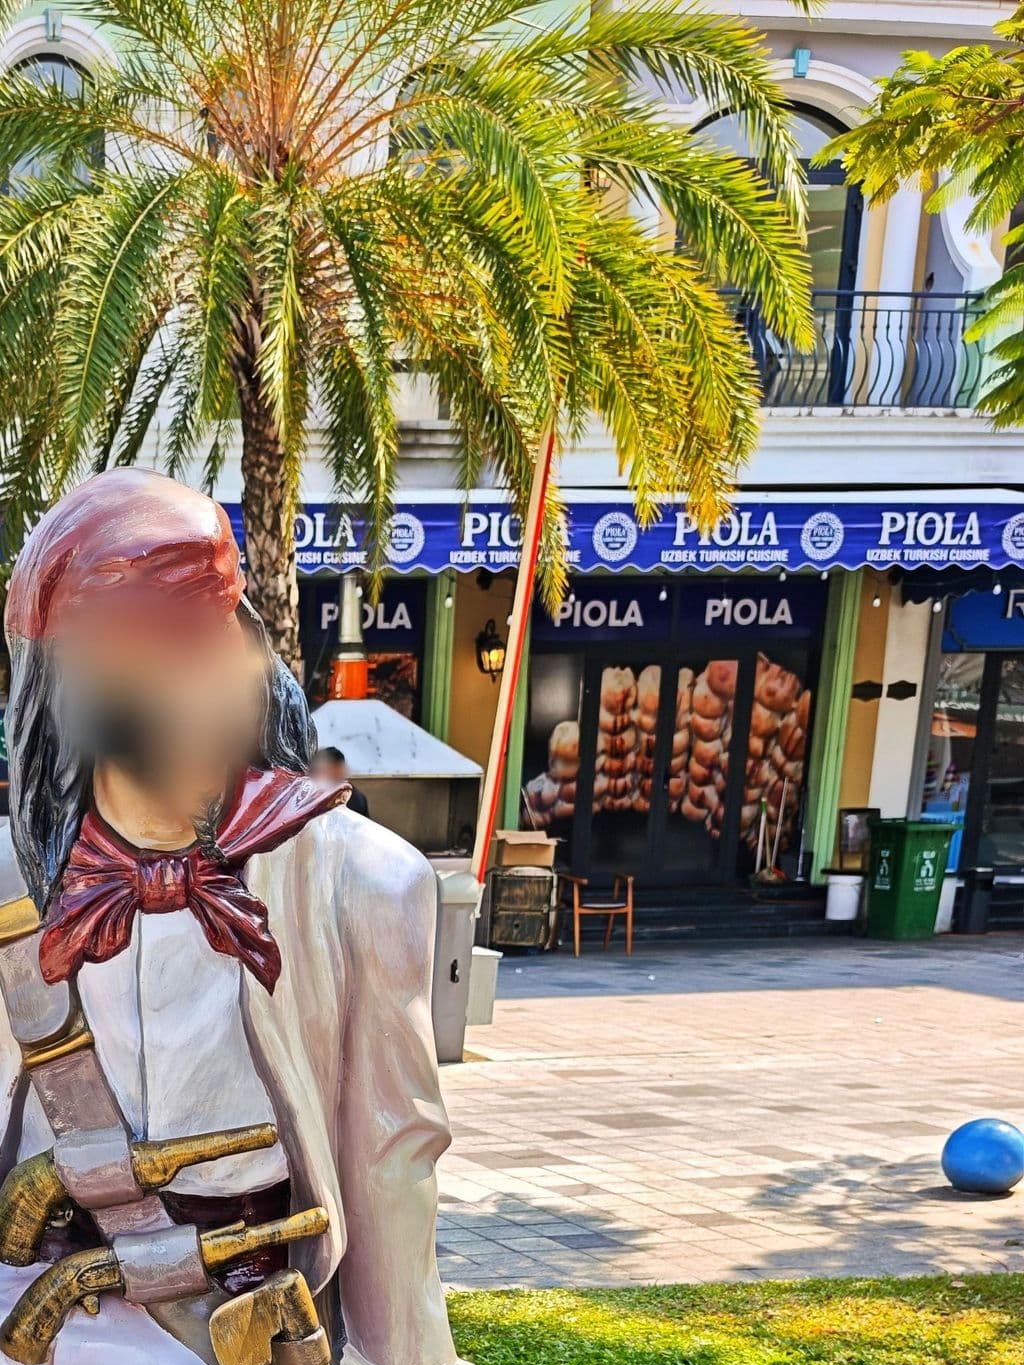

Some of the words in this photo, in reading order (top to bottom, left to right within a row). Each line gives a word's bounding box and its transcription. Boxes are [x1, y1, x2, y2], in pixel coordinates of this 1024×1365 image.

[294, 513, 357, 548] OLA
[461, 512, 571, 547] PIOA
[673, 511, 779, 547] PIOLA
[878, 511, 981, 546] PIOLA
[323, 551, 368, 564] CUISINE
[449, 550, 486, 564] UZBEK
[660, 549, 696, 563] UZBEK
[699, 549, 745, 562] TURKISH
[746, 549, 789, 562] CUISINE
[866, 548, 902, 562] UZBEK
[903, 548, 948, 561] TURKISH
[949, 548, 990, 561] CUISINE
[321, 602, 413, 630] PLA
[553, 600, 644, 628] PIOLA
[704, 598, 793, 627] PIOLA
